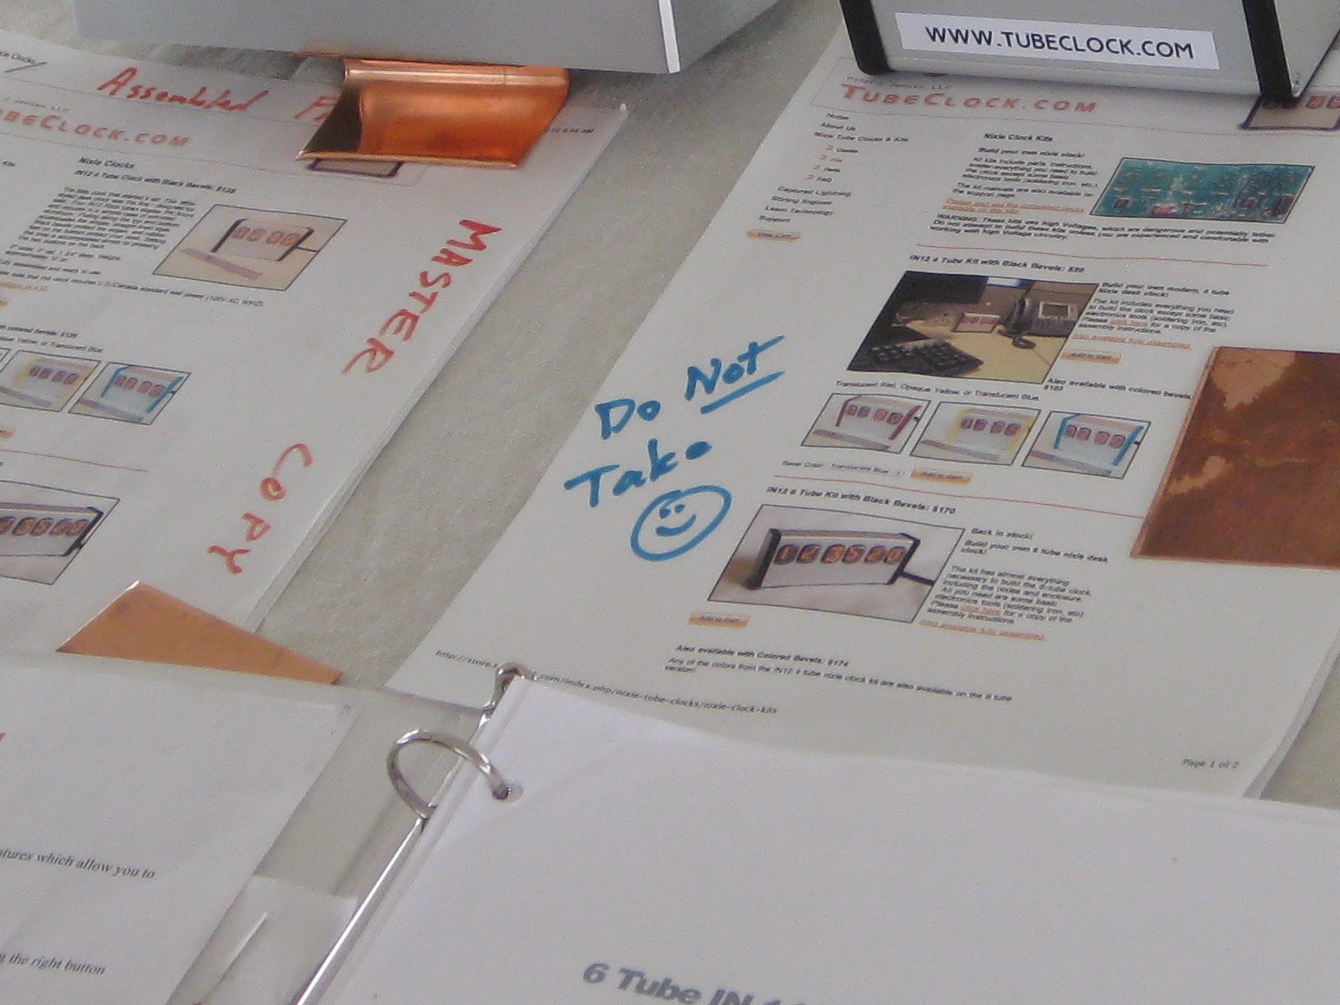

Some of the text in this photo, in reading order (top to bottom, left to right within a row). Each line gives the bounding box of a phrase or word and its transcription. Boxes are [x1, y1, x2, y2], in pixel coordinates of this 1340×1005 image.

[924, 25, 1194, 61] WWW.TUBECLOCK.COM
[594, 334, 786, 441] Do Not
[563, 437, 713, 509] Take
[36, 852, 75, 868] which
[76, 858, 113, 874] allow
[112, 866, 141, 878] you
[141, 869, 156, 880] to
[9, 952, 31, 966] the
[32, 956, 64, 971] right
[64, 958, 107, 976] button
[582, 961, 610, 985] 6
[617, 966, 702, 1005] Tube
